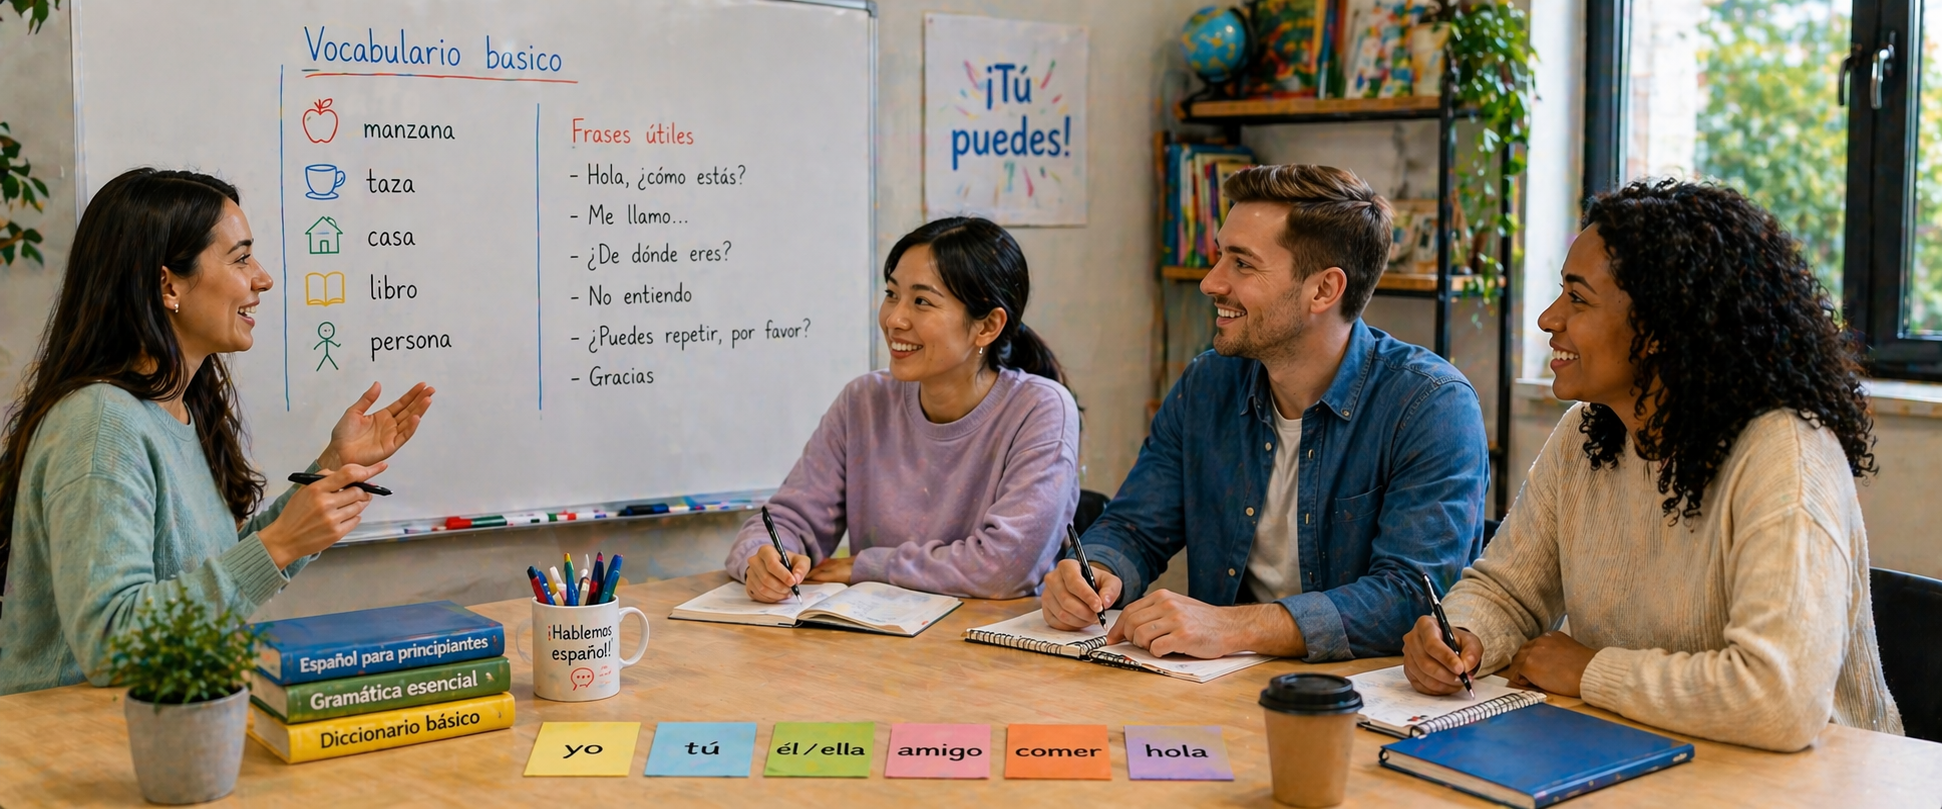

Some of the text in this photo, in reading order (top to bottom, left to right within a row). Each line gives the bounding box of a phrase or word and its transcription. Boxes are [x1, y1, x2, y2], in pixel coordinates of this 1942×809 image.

[303, 25, 562, 72] Vocabulario basico
[986, 62, 1032, 111] ¡Tú
[363, 123, 456, 140] manzana
[572, 117, 694, 145] Frases útiles
[951, 114, 1071, 172] puedes!
[365, 168, 416, 194] taza
[587, 162, 630, 189] Hola,
[637, 166, 686, 191] ¿cómo
[696, 164, 747, 186] estás?
[588, 203, 615, 226] Me
[627, 203, 689, 225] llamo...
[367, 230, 416, 247] casa
[587, 242, 620, 271] ¿De
[631, 242, 678, 264] dónde
[689, 240, 732, 262] eres?
[370, 273, 418, 301] libro
[589, 284, 612, 307] No
[623, 282, 693, 305] entiendo
[370, 333, 453, 363] persona
[588, 324, 654, 354] ¿Puedes
[665, 323, 723, 352] repetir,
[731, 327, 756, 350] por
[764, 317, 812, 340] favor?
[589, 365, 655, 387] Gracias
[299, 636, 489, 675] Español para principiantes
[309, 669, 479, 711] Gramática esencial
[320, 711, 481, 749] Diccionario básico
[562, 743, 604, 760] yo
[684, 740, 720, 756] tú
[897, 743, 983, 761] amigo
[1015, 745, 1103, 758] comer
[1145, 743, 1210, 758] hola
